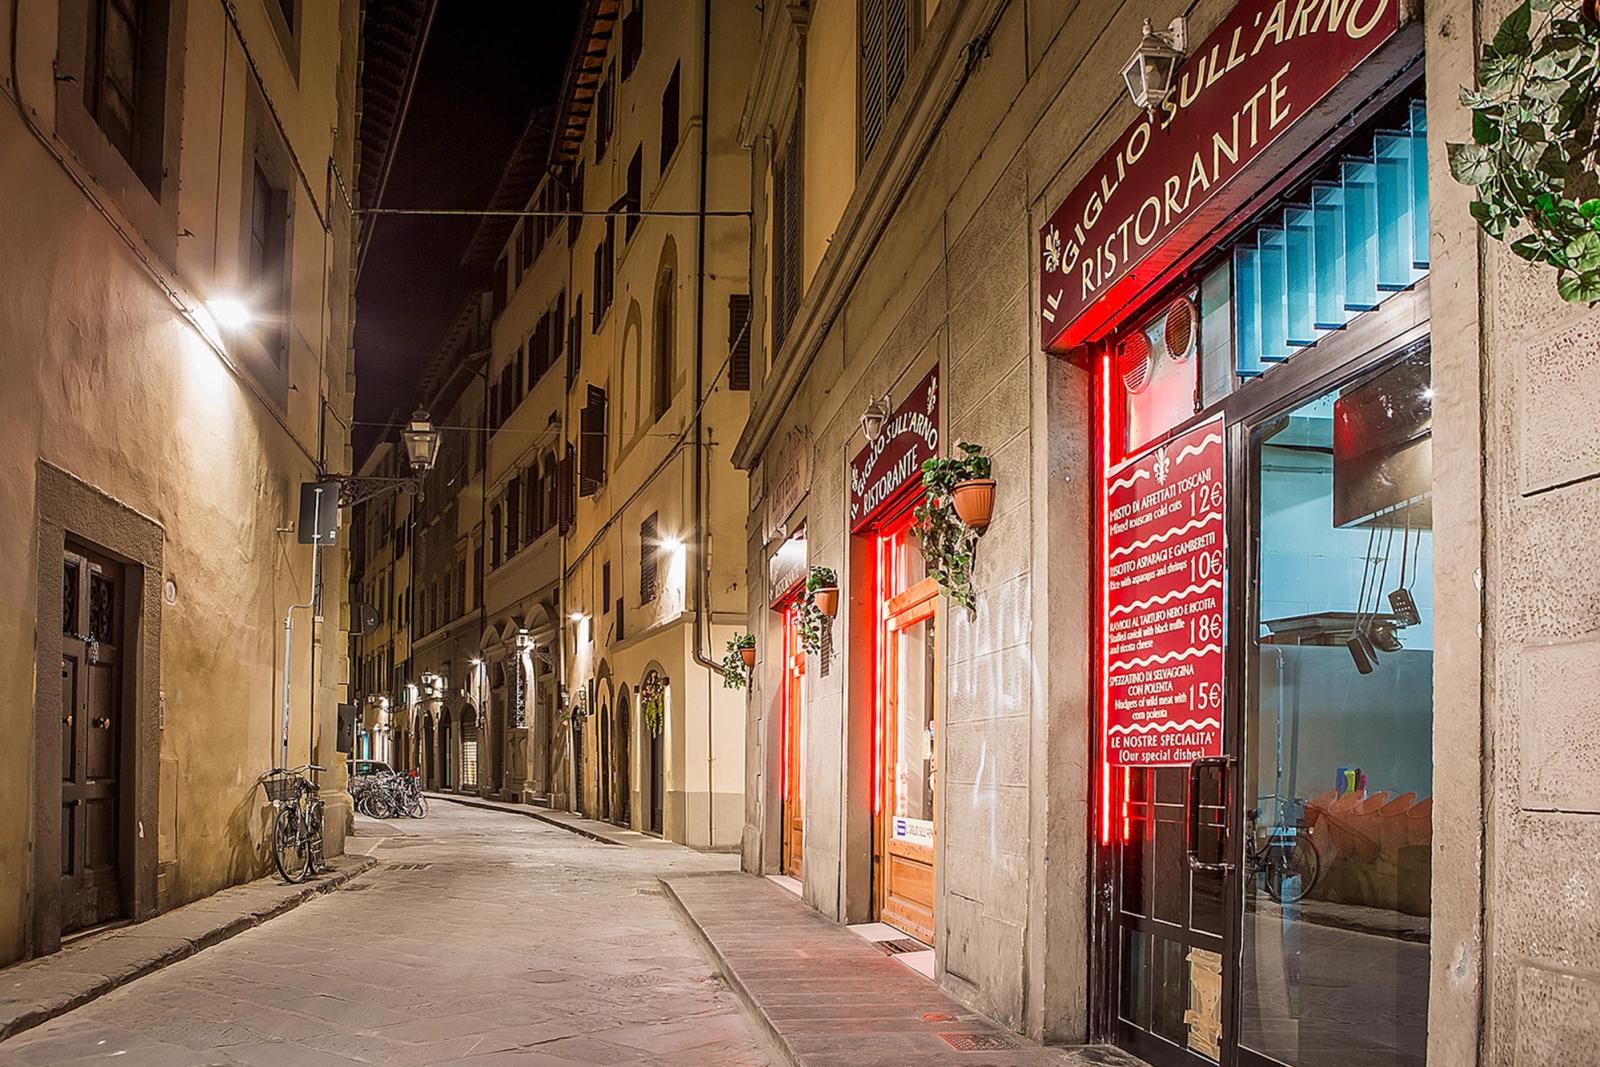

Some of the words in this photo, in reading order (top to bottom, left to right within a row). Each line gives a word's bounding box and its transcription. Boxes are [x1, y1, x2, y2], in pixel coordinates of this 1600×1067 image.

[1042, 289, 1063, 323] IL
[1062, 120, 1152, 277] GIGLIO
[1160, 0, 1390, 129] SULL'ARNO
[1081, 62, 1291, 301] RISTORANTE
[858, 435, 885, 497] GIGLIO
[886, 411, 938, 450] SULL'ARNO
[863, 443, 919, 516] RISTORANTE
[1110, 504, 1131, 522] MISTO
[1132, 499, 1140, 513] DI
[1141, 484, 1176, 510] AFFETTATI
[1177, 467, 1212, 494] TOSCANI
[1190, 481, 1222, 517] 12€
[1110, 519, 1128, 536] Mixed
[1154, 503, 1168, 519] cold
[1109, 560, 1136, 577] RISOTTO
[1136, 548, 1168, 570] ASPARAGI
[1169, 547, 1174, 560] E
[1174, 531, 1216, 557] GAMBERETTI
[1190, 549, 1222, 582] 10€
[1109, 580, 1120, 591] Rice
[1121, 574, 1132, 588] with
[1110, 620, 1132, 632] RAVIOLI
[1132, 617, 1139, 628] AL
[1140, 610, 1166, 626] TARTUFO
[1166, 606, 1184, 619] NERO
[1184, 604, 1188, 614] E
[1189, 597, 1216, 614] RICOTTA
[1190, 614, 1222, 644] 18€
[1128, 684, 1144, 696] CON
[1144, 681, 1174, 694] POLENTA
[1146, 670, 1152, 682] DI
[1153, 664, 1194, 680] SELVAGGINA
[1190, 682, 1221, 710] 15€
[1111, 736, 1120, 748] LE
[1123, 734, 1158, 748] NOSTRE
[1160, 732, 1215, 747] SPECIALITA'
[1119, 750, 1139, 763] (Our
[1142, 748, 1170, 763] special
